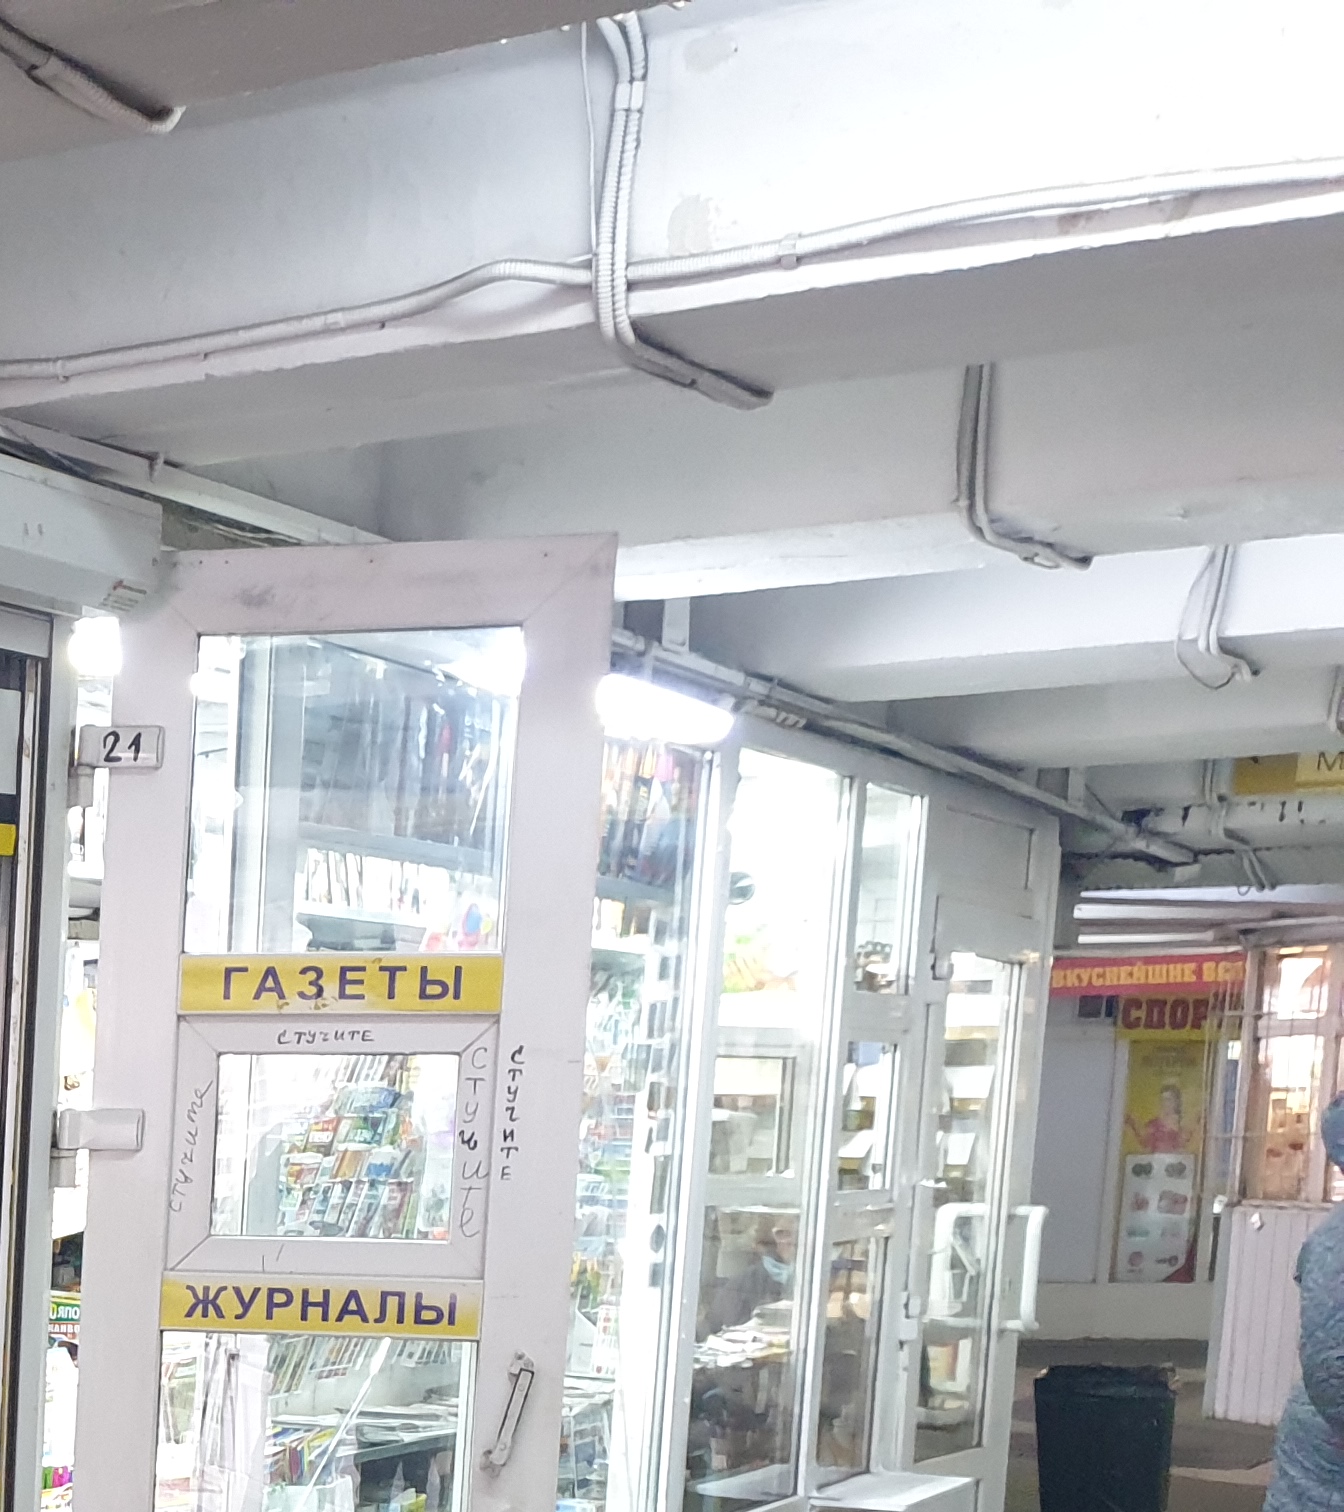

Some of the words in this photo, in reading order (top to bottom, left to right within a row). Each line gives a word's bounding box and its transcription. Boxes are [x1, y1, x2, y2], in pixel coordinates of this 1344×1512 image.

[103, 731, 143, 763] 21
[222, 966, 462, 1001] ГАЗЕТЫ
[1052, 962, 1196, 988] ВКУСНЕЙШИЕ
[184, 1285, 457, 1327] ЖУРНАЛЫ
